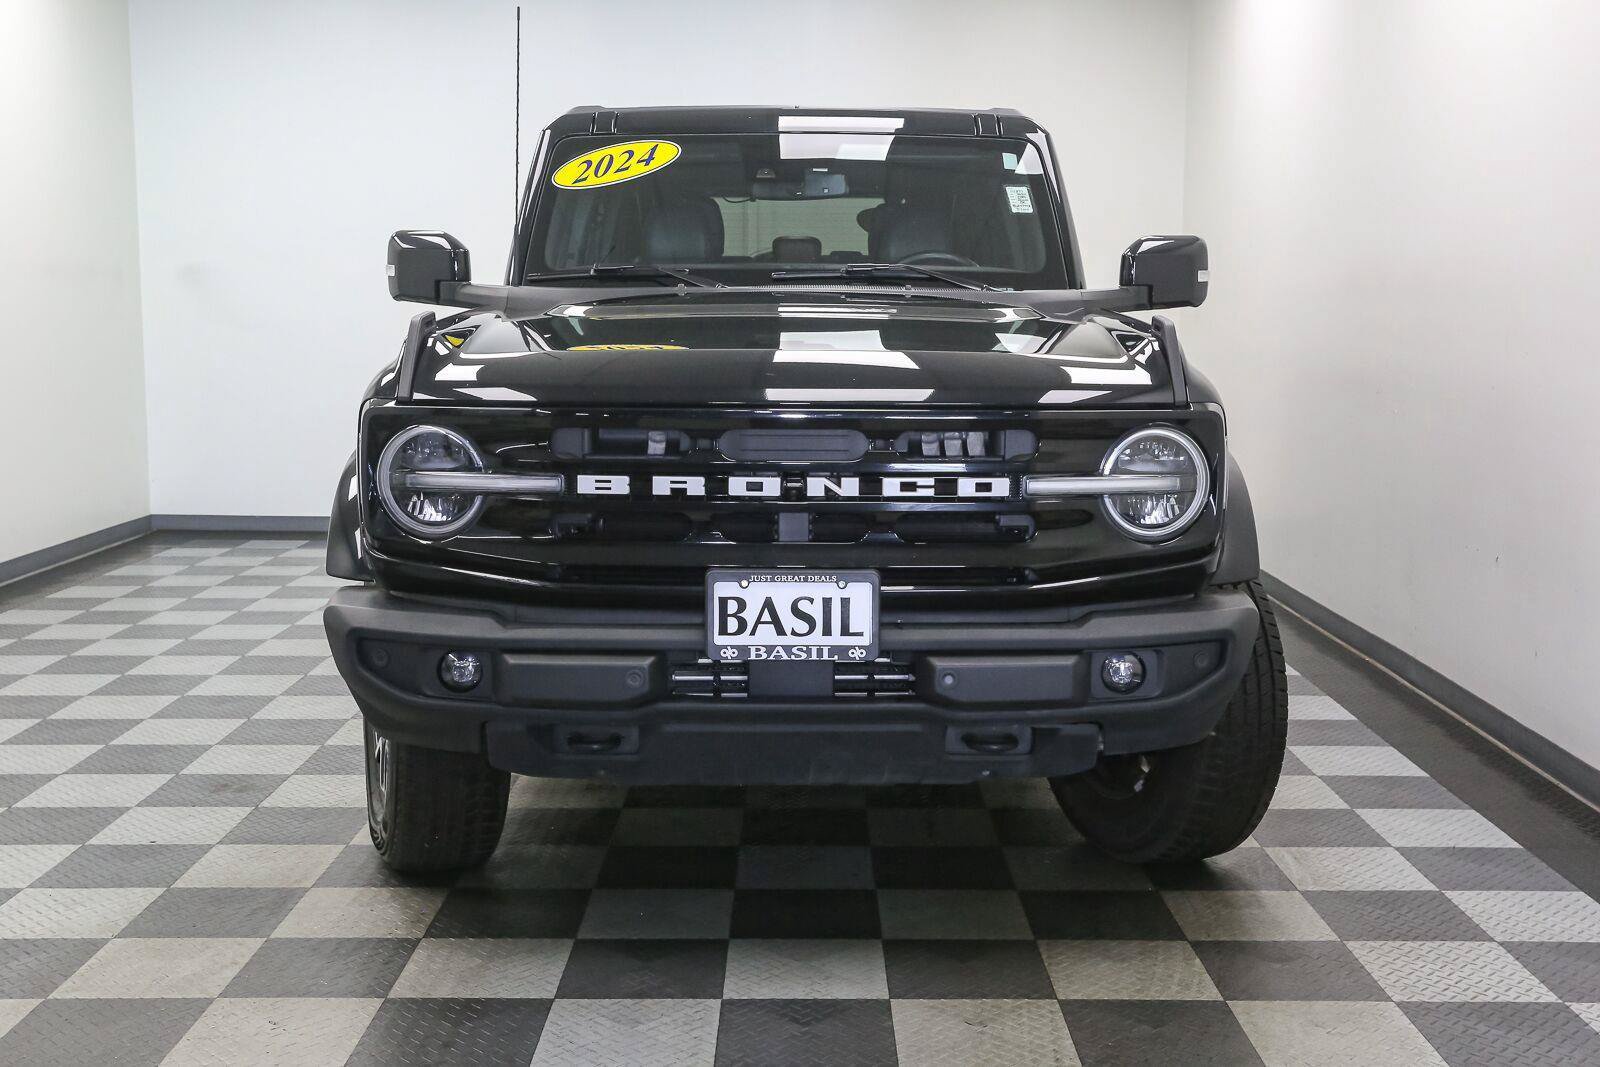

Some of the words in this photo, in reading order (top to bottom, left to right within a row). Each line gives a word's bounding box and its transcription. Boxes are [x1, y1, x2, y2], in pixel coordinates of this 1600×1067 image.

[571, 143, 659, 185] 2024
[576, 474, 1010, 498] BRONCO
[717, 596, 864, 637] BASIL
[747, 645, 838, 660] BASIL
